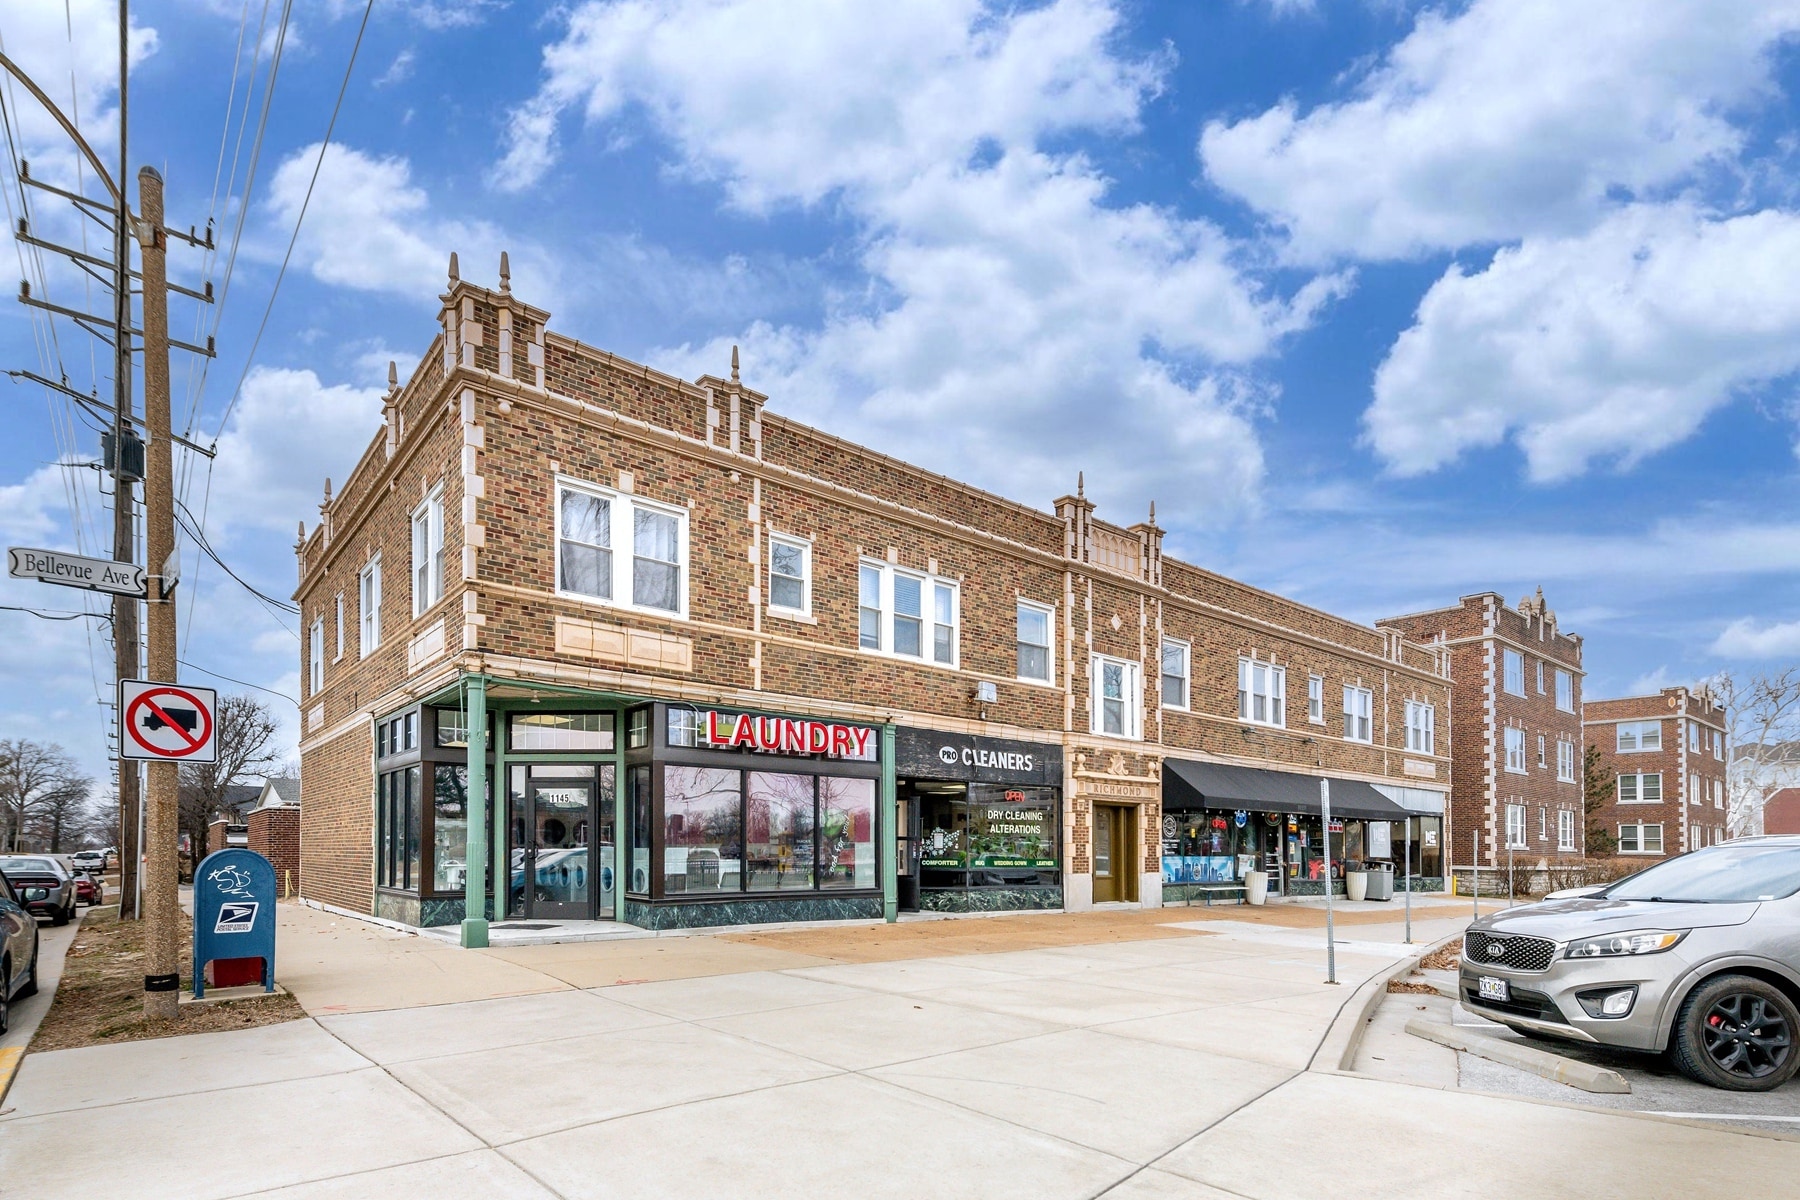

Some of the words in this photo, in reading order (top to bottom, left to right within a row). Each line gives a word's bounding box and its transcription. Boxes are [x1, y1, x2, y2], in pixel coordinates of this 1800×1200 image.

[24, 553, 93, 580] Bellevue
[101, 566, 130, 585] Ave
[706, 710, 871, 756] LAUNDRY
[941, 750, 957, 760] PRO
[961, 748, 1033, 772] CLEANERS
[1004, 789, 1025, 802] OPEN
[1093, 783, 1142, 797] RICHMOND
[550, 794, 569, 803] 1145
[987, 810, 1004, 820] DRY
[1005, 811, 1043, 821] CLEANING
[990, 824, 1041, 834] ALTERATIONS
[1490, 946, 1500, 954] KIA
